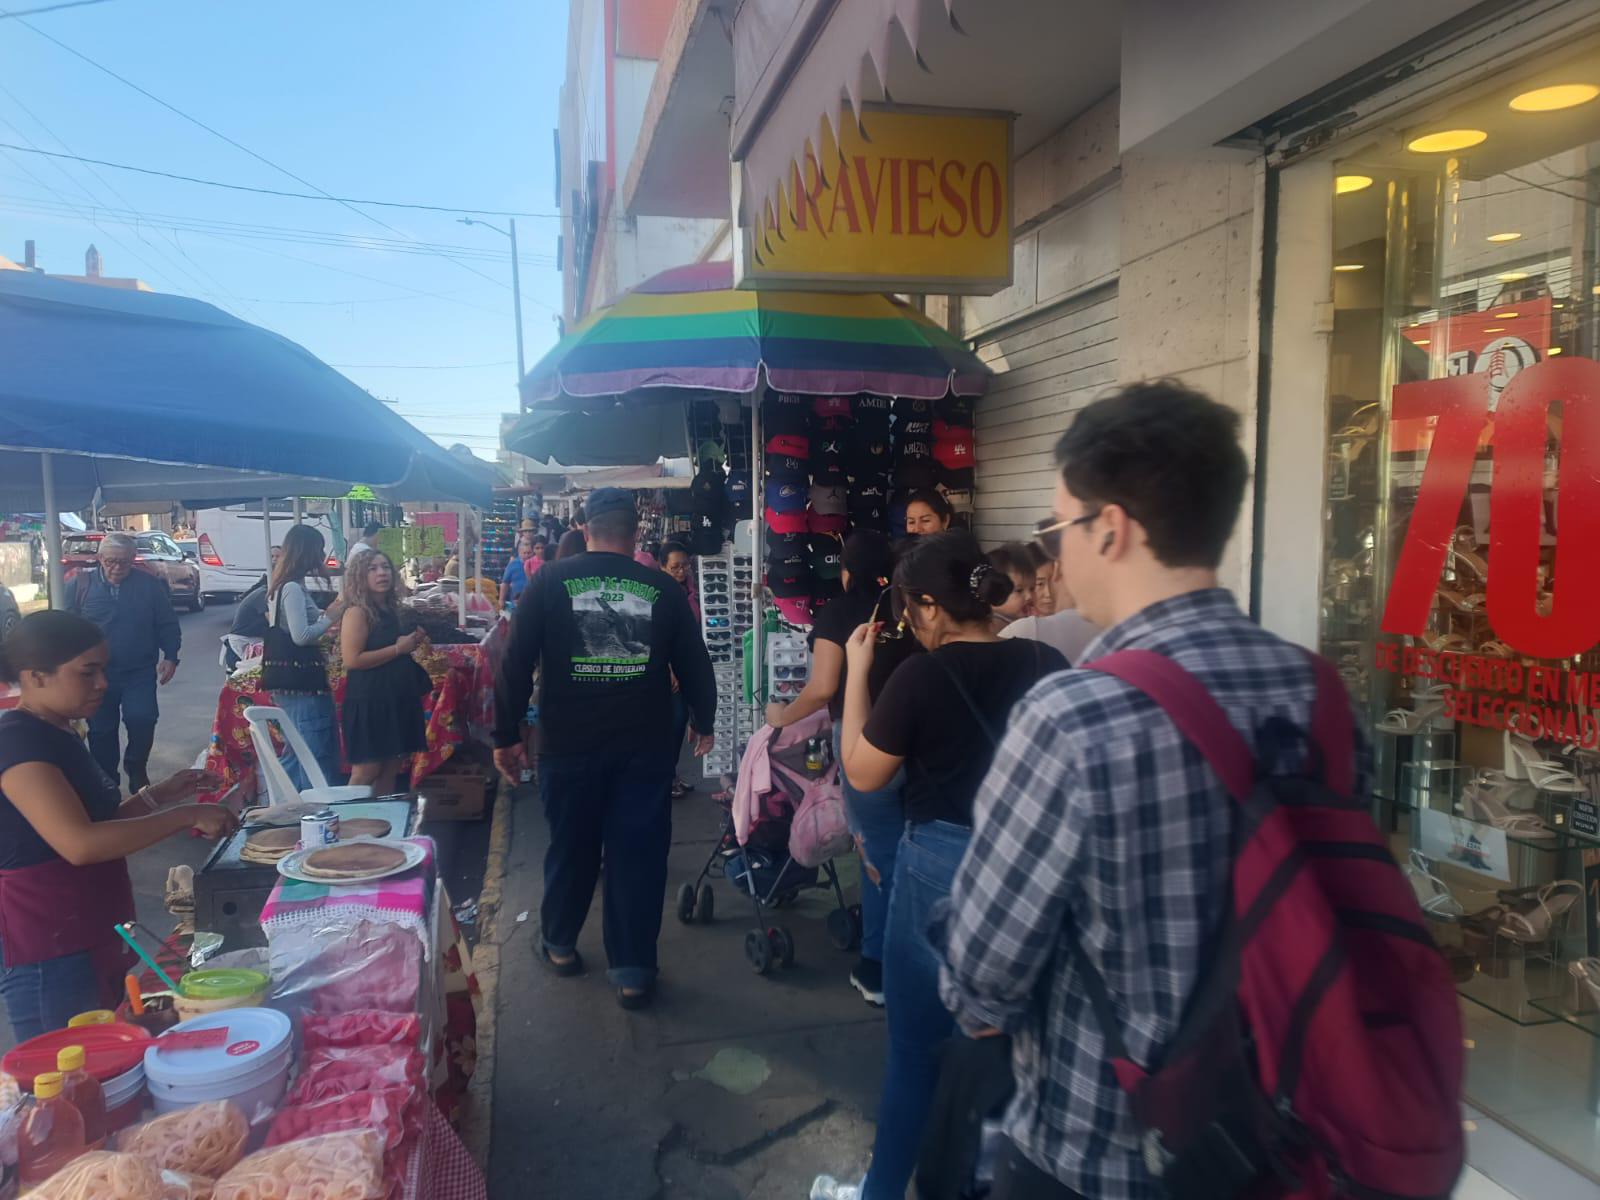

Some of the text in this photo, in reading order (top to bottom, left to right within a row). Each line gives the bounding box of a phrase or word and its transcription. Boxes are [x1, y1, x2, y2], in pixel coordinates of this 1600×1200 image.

[768, 150, 1003, 239] RAVIESO
[600, 591, 625, 602] 2023
[1375, 641, 1398, 673] DE
[1402, 645, 1524, 695] DESCUENTO
[1528, 665, 1560, 702] EN
[1442, 688, 1600, 752] SELECCIONAD
